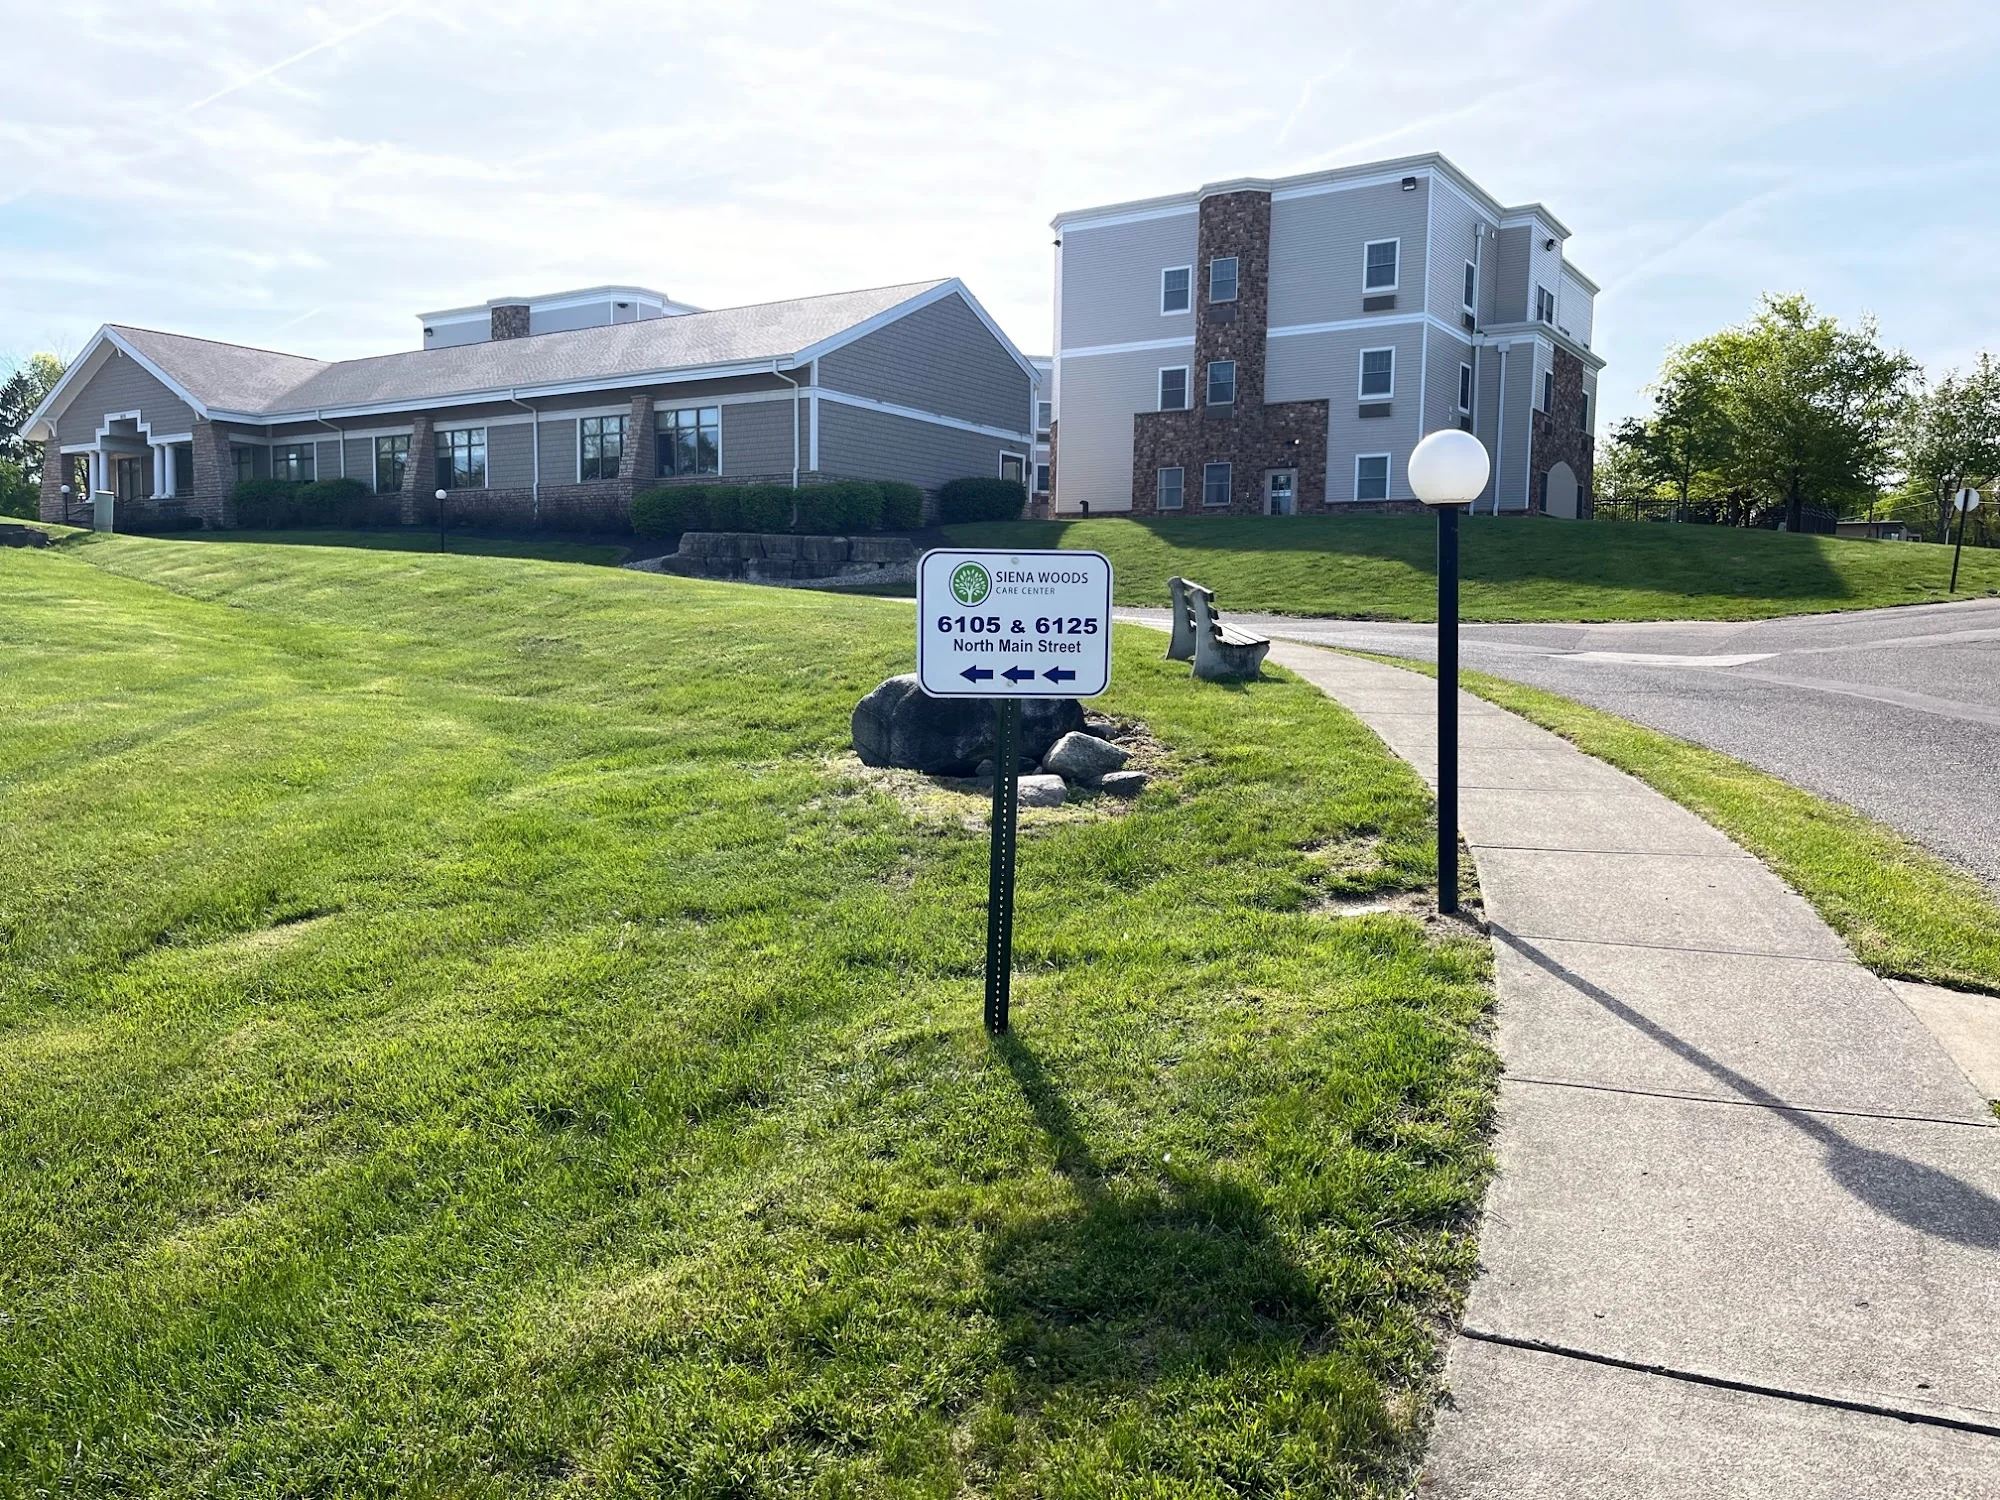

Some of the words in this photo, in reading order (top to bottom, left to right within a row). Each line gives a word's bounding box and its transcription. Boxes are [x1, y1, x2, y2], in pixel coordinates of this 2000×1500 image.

[996, 571, 1034, 583] SIENA
[1038, 572, 1089, 584] WOODS
[996, 587, 1019, 595] CARE
[1021, 587, 1056, 595] CENTER
[937, 616, 1001, 633] 6105
[1010, 619, 1026, 634] &
[1035, 617, 1098, 634] 6125
[953, 639, 994, 652] North
[998, 639, 1033, 653] Main
[1038, 639, 1082, 653] Street
